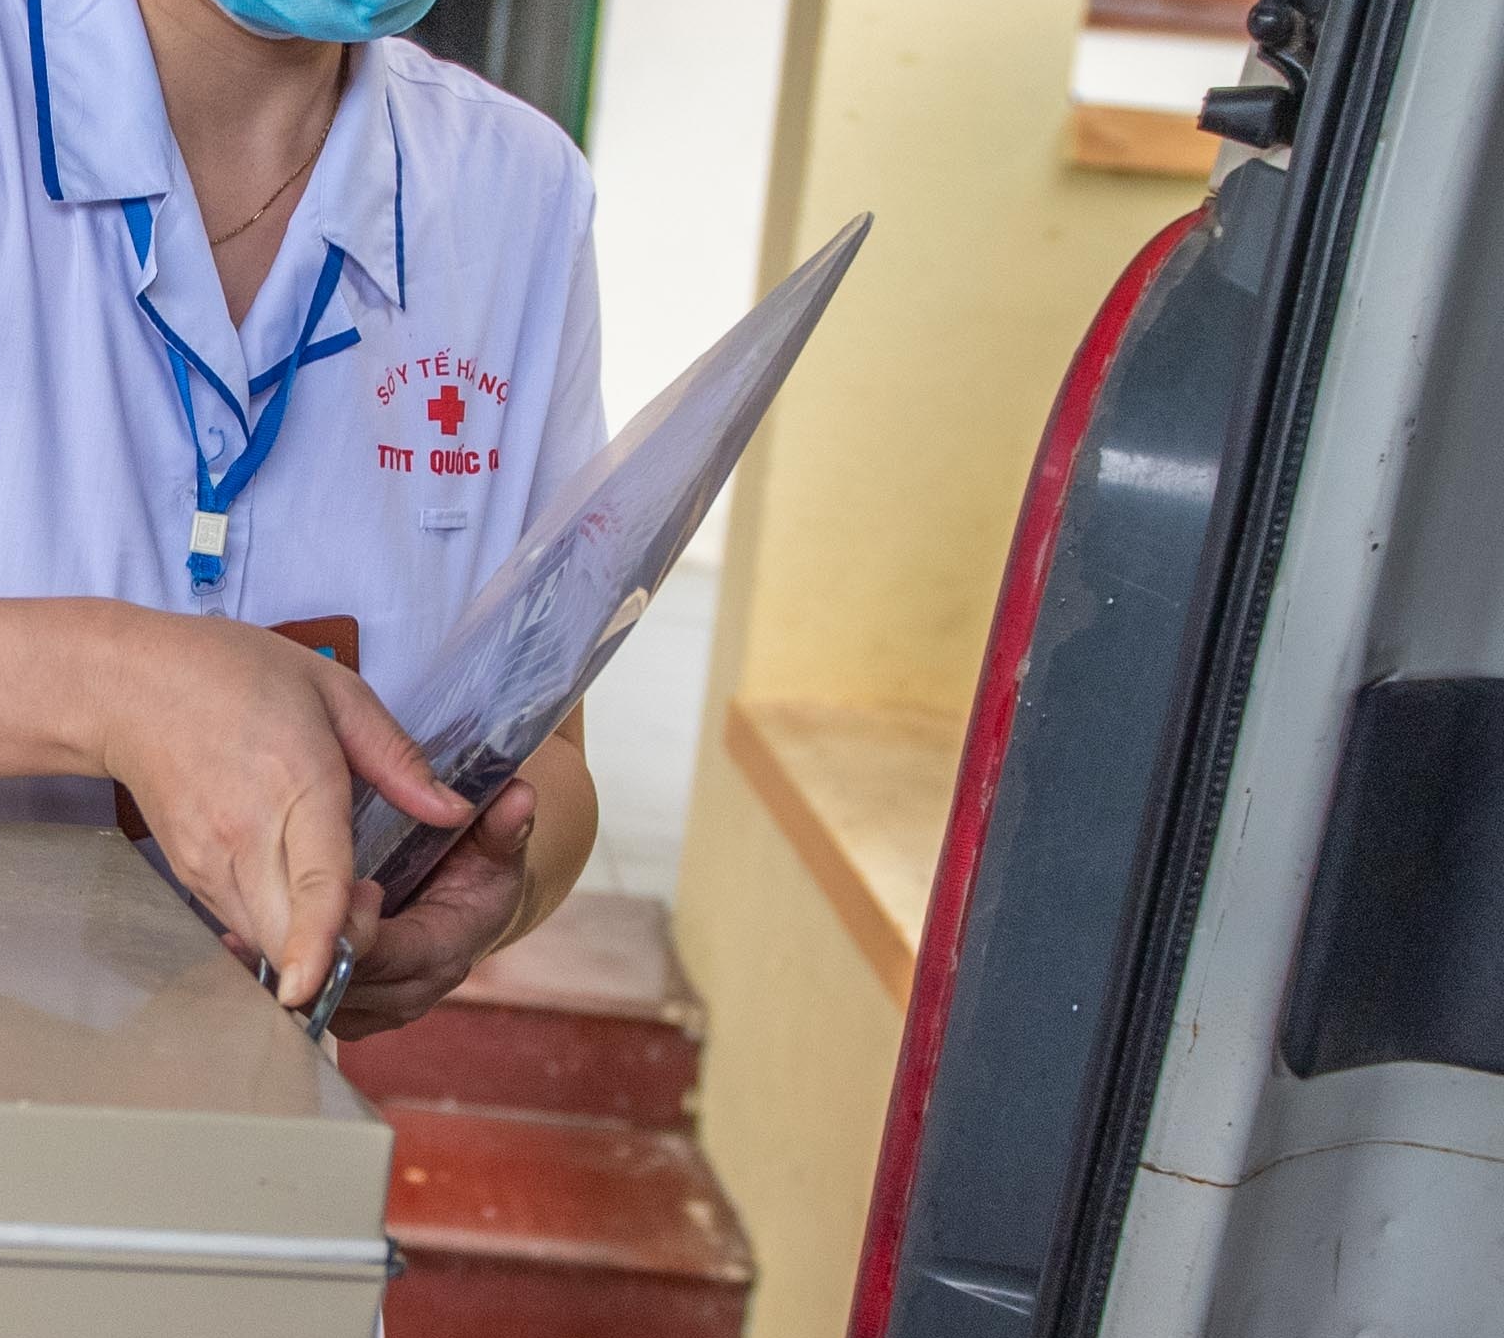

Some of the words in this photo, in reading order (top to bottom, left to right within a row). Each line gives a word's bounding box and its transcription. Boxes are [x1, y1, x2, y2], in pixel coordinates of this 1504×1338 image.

[376, 366, 396, 405] SỞ
[396, 364, 408, 384] Y
[416, 348, 451, 378] TẾ
[478, 372, 511, 405] NỘ
[378, 444, 414, 472] TTYT
[430, 443, 481, 476] QUỐC
